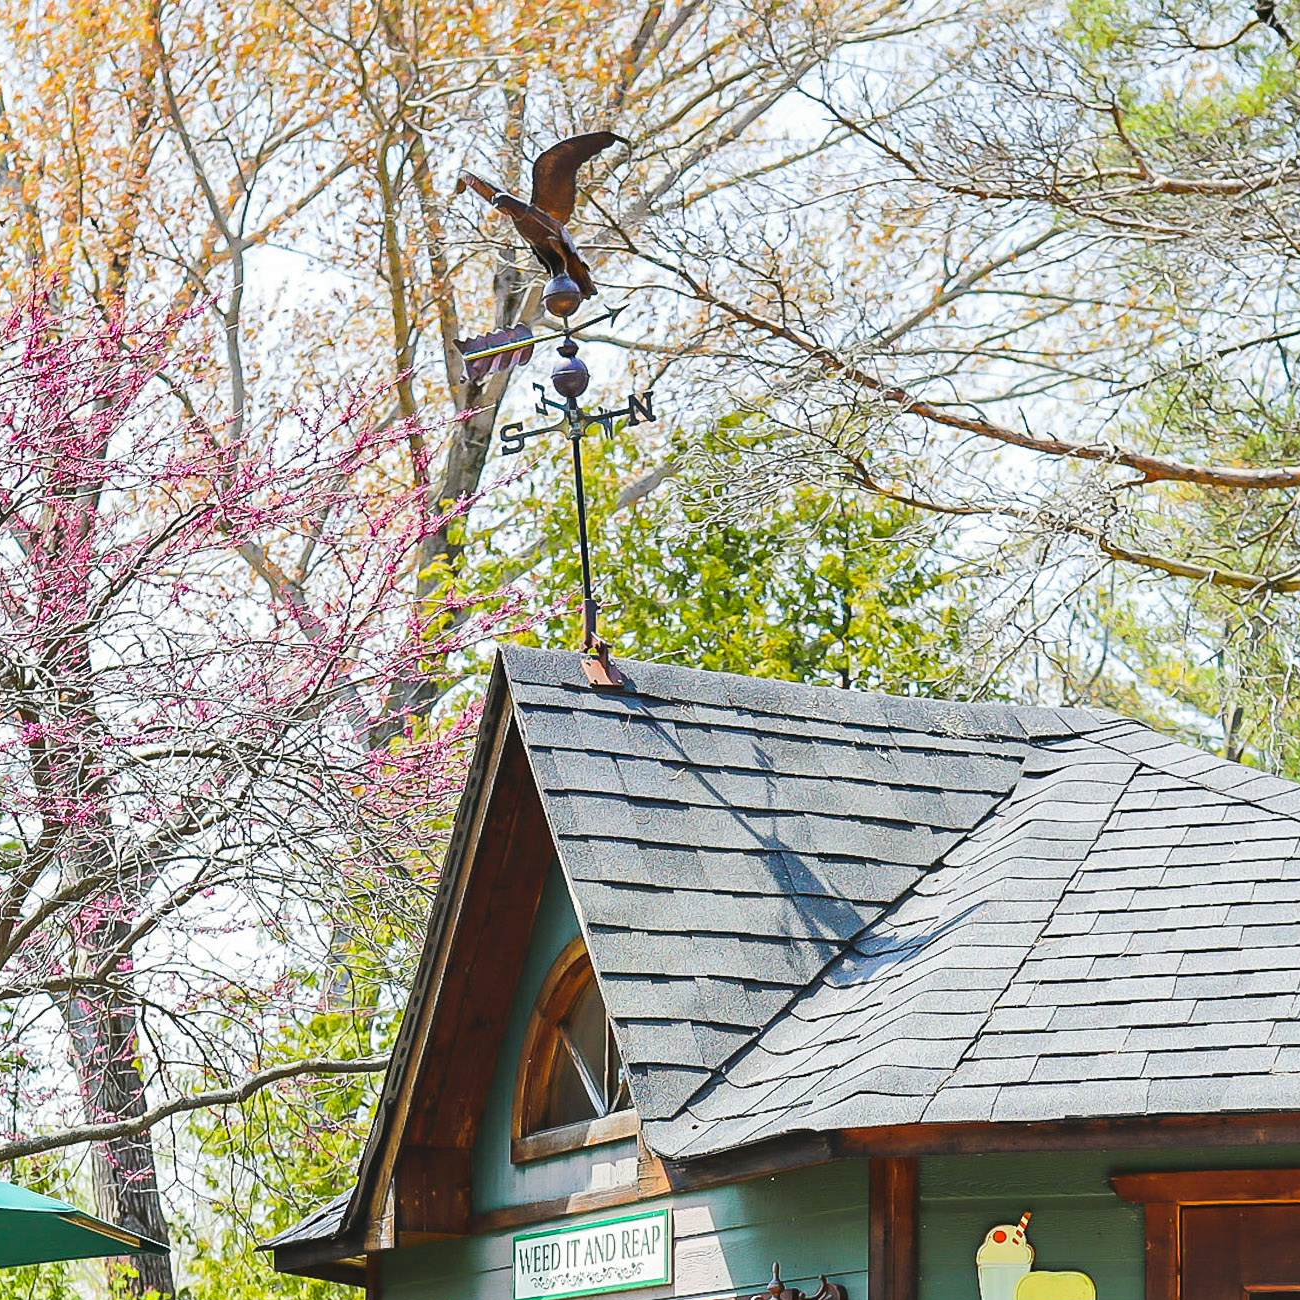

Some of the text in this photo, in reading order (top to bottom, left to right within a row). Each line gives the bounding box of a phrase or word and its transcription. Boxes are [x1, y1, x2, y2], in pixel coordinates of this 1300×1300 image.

[628, 391, 657, 427] N
[500, 421, 525, 456] S
[519, 1225, 661, 1275] WEED IT AND REAP
